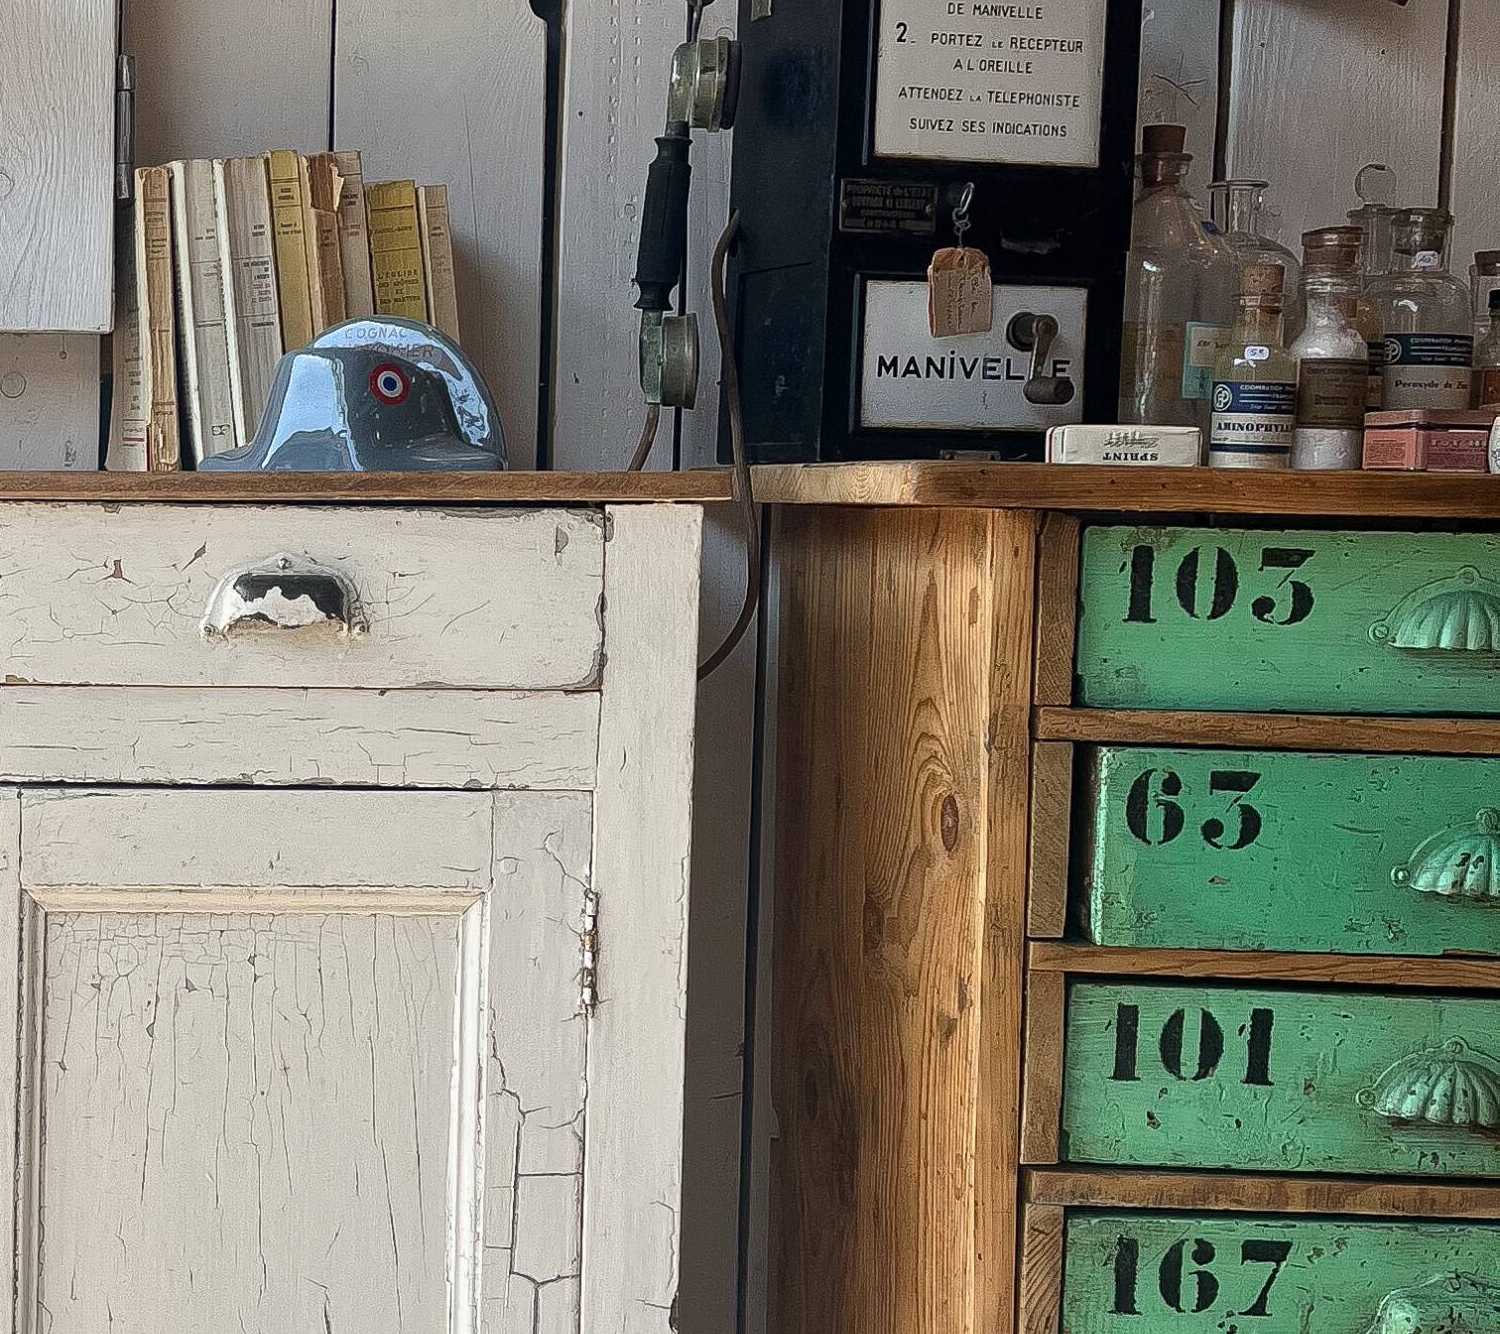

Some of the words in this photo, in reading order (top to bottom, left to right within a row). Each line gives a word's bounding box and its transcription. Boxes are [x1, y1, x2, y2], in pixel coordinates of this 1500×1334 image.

[947, 2, 965, 16] DE
[972, 4, 1044, 20] MANIVELLE
[931, 33, 984, 48] PORTEZ
[899, 86, 963, 102] ATTENDEZ
[909, 117, 954, 132] SUIVEZ
[961, 120, 986, 134] SES
[992, 122, 1068, 138] INDICATIONS
[344, 327, 408, 340] COGNAC
[1102, 452, 1159, 462] SPRINT
[1119, 544, 1316, 626] 103
[1125, 768, 1262, 850] 63
[1108, 1001, 1275, 1087] 101
[1108, 1234, 1294, 1317] 167
